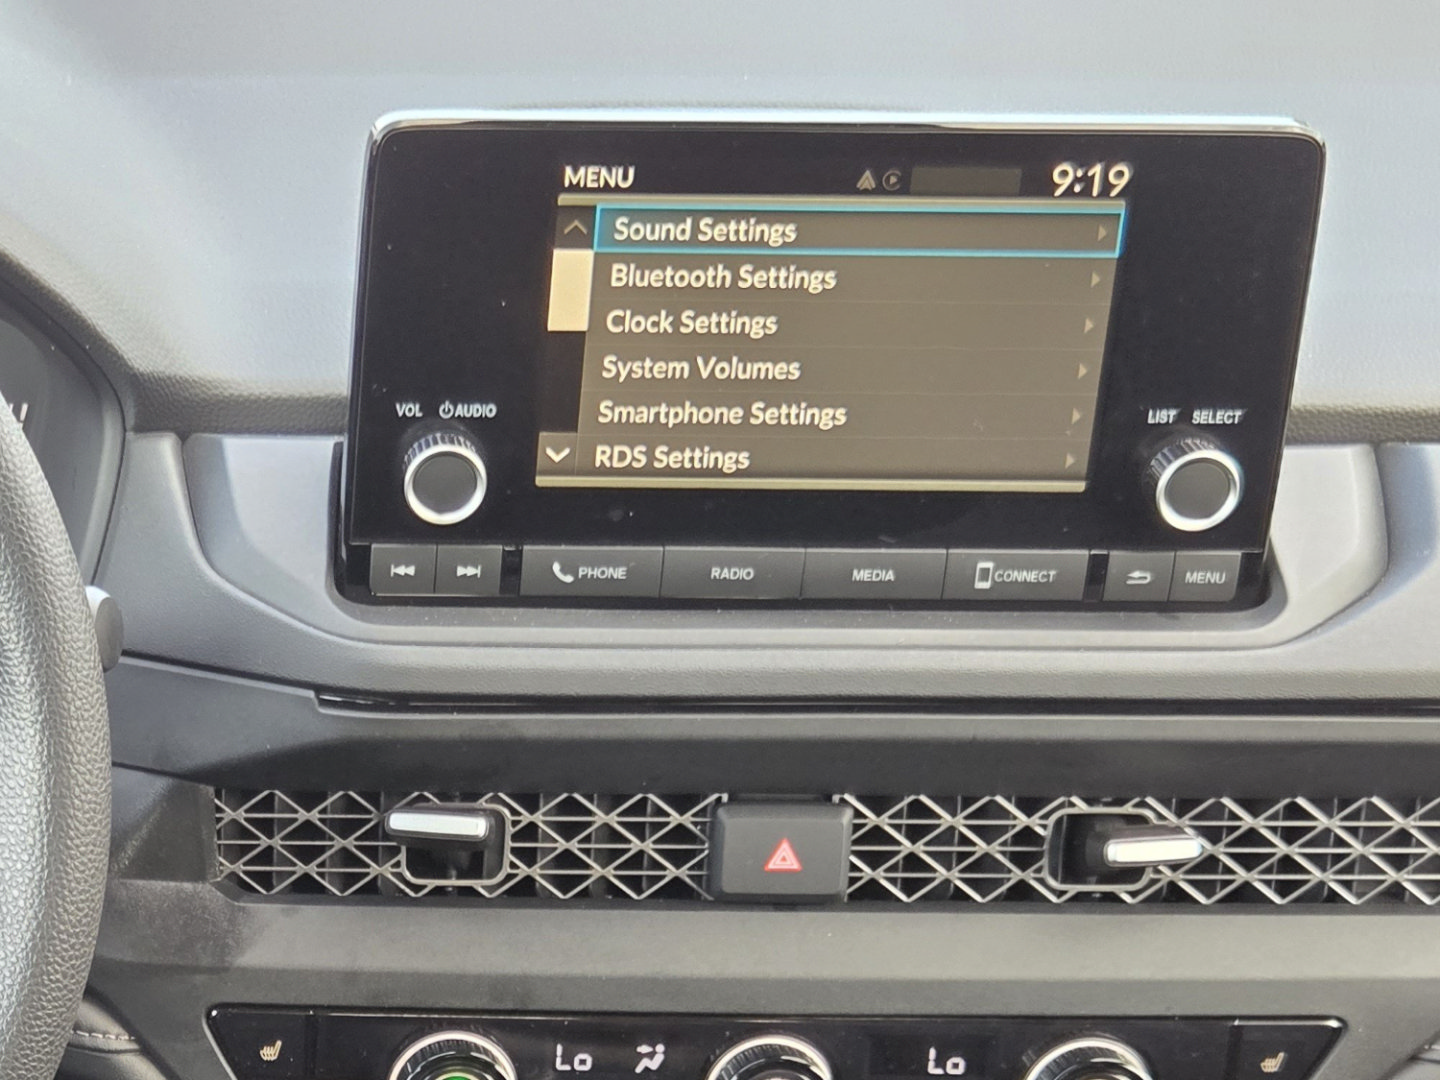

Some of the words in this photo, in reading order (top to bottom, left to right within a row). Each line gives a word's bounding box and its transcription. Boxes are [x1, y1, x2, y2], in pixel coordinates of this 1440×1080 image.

[564, 166, 635, 190] MENU
[1052, 161, 1132, 199] 9:19
[613, 217, 690, 243] Sound
[697, 218, 798, 248] Settings
[610, 264, 732, 290] Bluetooth
[737, 266, 837, 294] Settings
[606, 310, 674, 335] Clock
[679, 311, 778, 339] Settings
[602, 355, 690, 383] System
[696, 356, 802, 381] Volumes
[395, 403, 423, 419] VOL
[454, 403, 497, 419] AUDIO
[598, 400, 742, 428] Smartphone
[749, 401, 848, 430] Settings
[1147, 409, 1177, 425] LIST
[1191, 409, 1243, 426] SELECT
[595, 445, 647, 469] RDS
[653, 446, 751, 472] Settings
[578, 564, 628, 582] PHONE
[710, 565, 755, 582] RADIO
[851, 567, 896, 583] MEDIA
[993, 568, 1057, 585] CONNECT
[1184, 569, 1227, 586] MENU
